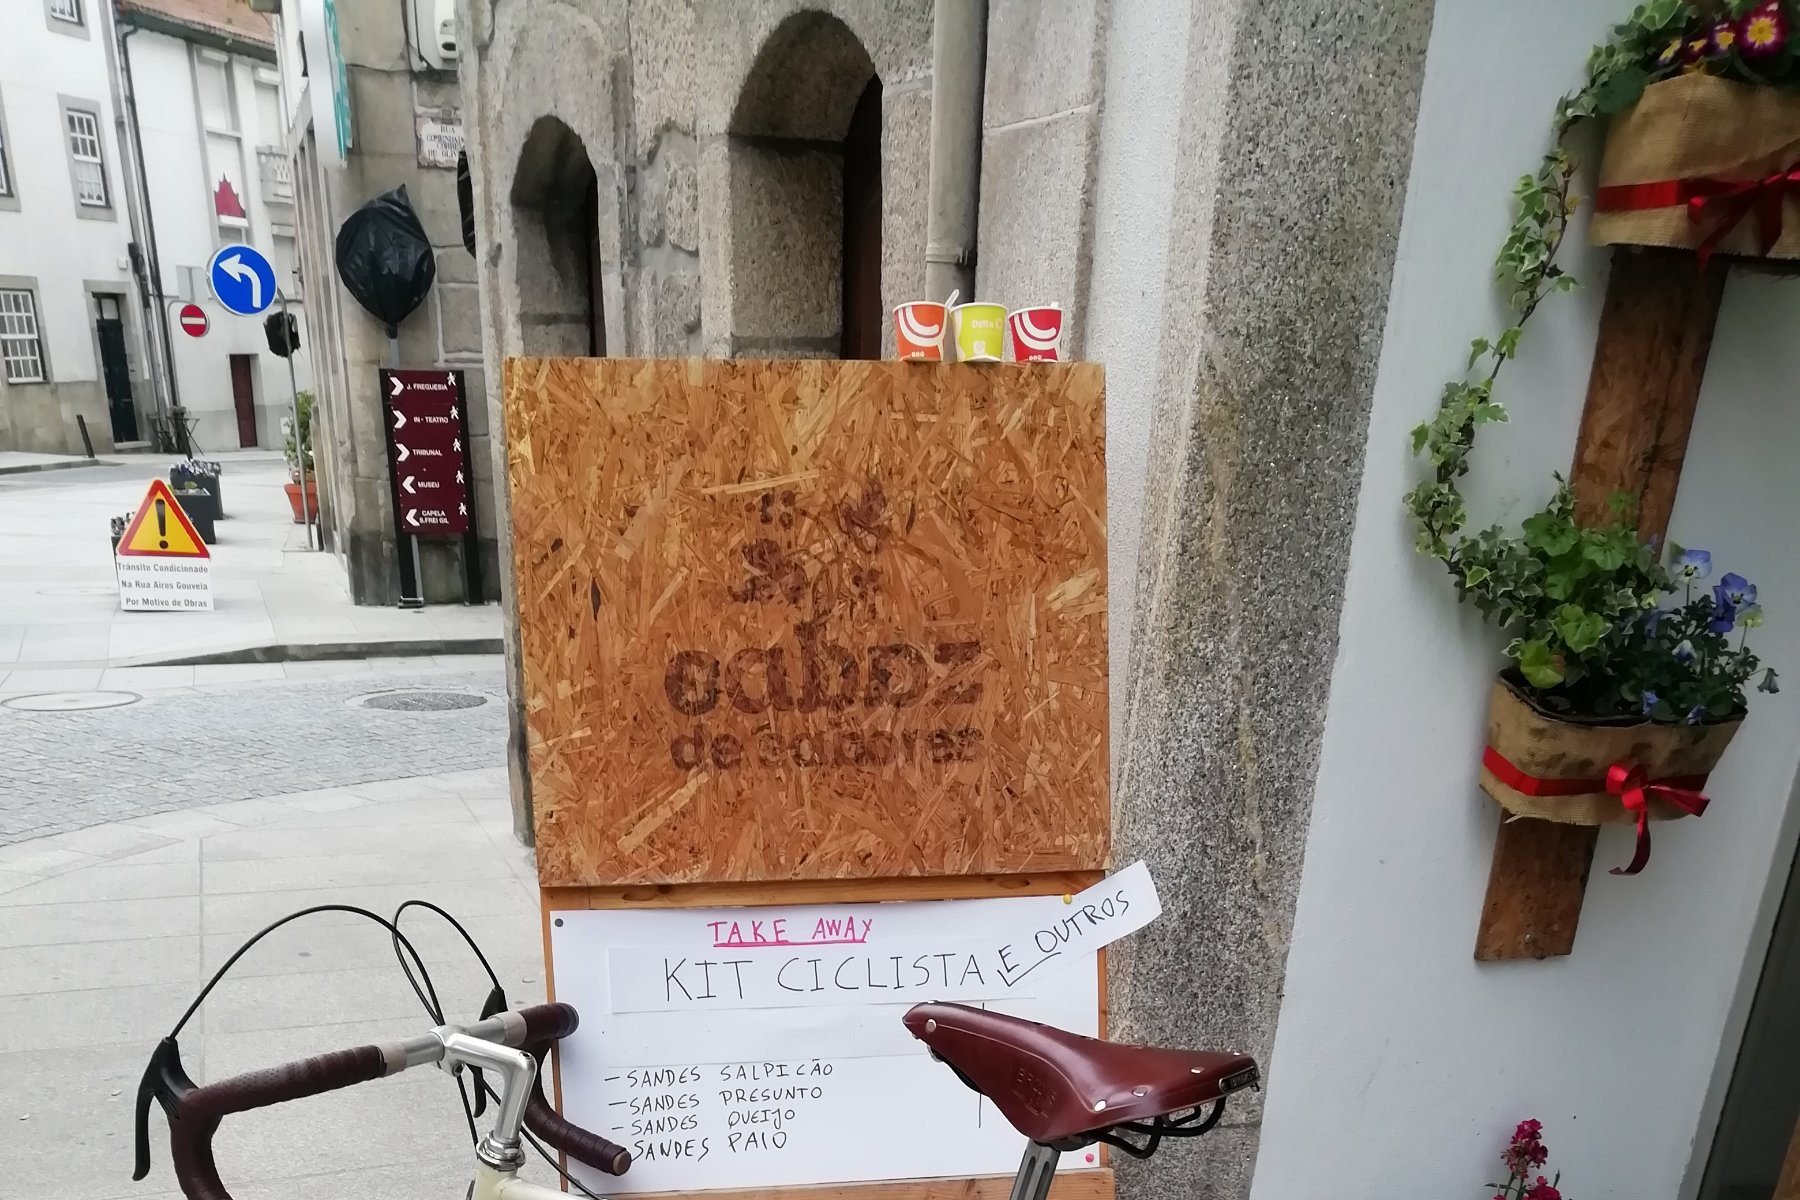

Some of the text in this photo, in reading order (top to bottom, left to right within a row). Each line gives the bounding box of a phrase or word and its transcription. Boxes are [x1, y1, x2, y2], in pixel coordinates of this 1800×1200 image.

[440, 125, 456, 133] RUA
[413, 383, 449, 391] FREGUESIA
[425, 416, 449, 424] TEATRO
[438, 517, 449, 525] GIL
[153, 563, 209, 573] Condicionado
[121, 580, 208, 590] Na Rua Aires Gouveia
[125, 597, 208, 608] Por Motivo de Obras
[670, 722, 743, 770] de
[706, 915, 873, 944] TAKE AWAY
[998, 889, 1130, 974] E OUTROS
[664, 951, 985, 1001] KIT CICLISTA
[719, 1058, 834, 1082] SALPICÃO
[718, 1085, 823, 1106] PRESUNTO
[727, 1107, 796, 1130] QUEIJO
[630, 1131, 788, 1162] SANDES PAIO
